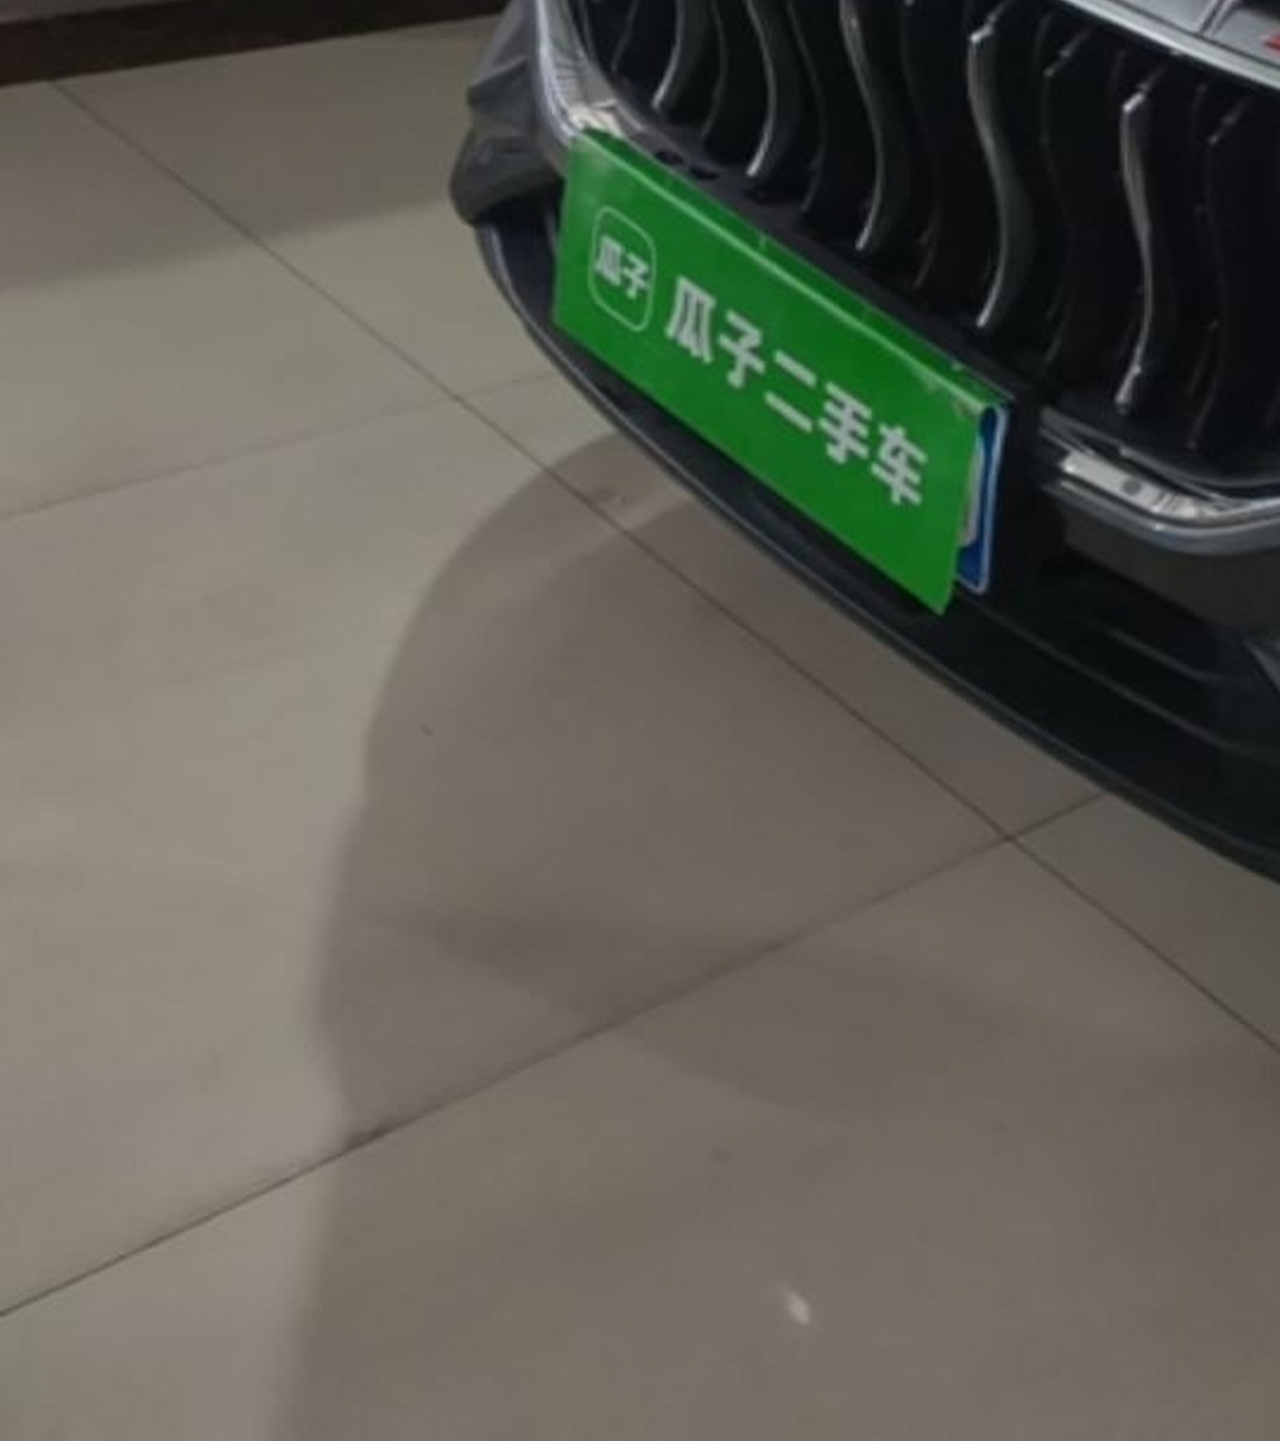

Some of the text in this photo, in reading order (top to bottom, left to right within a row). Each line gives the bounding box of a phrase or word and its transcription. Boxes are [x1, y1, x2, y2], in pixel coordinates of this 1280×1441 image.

[593, 234, 651, 301] 瓜子
[665, 274, 929, 507] 瓜子二手车
